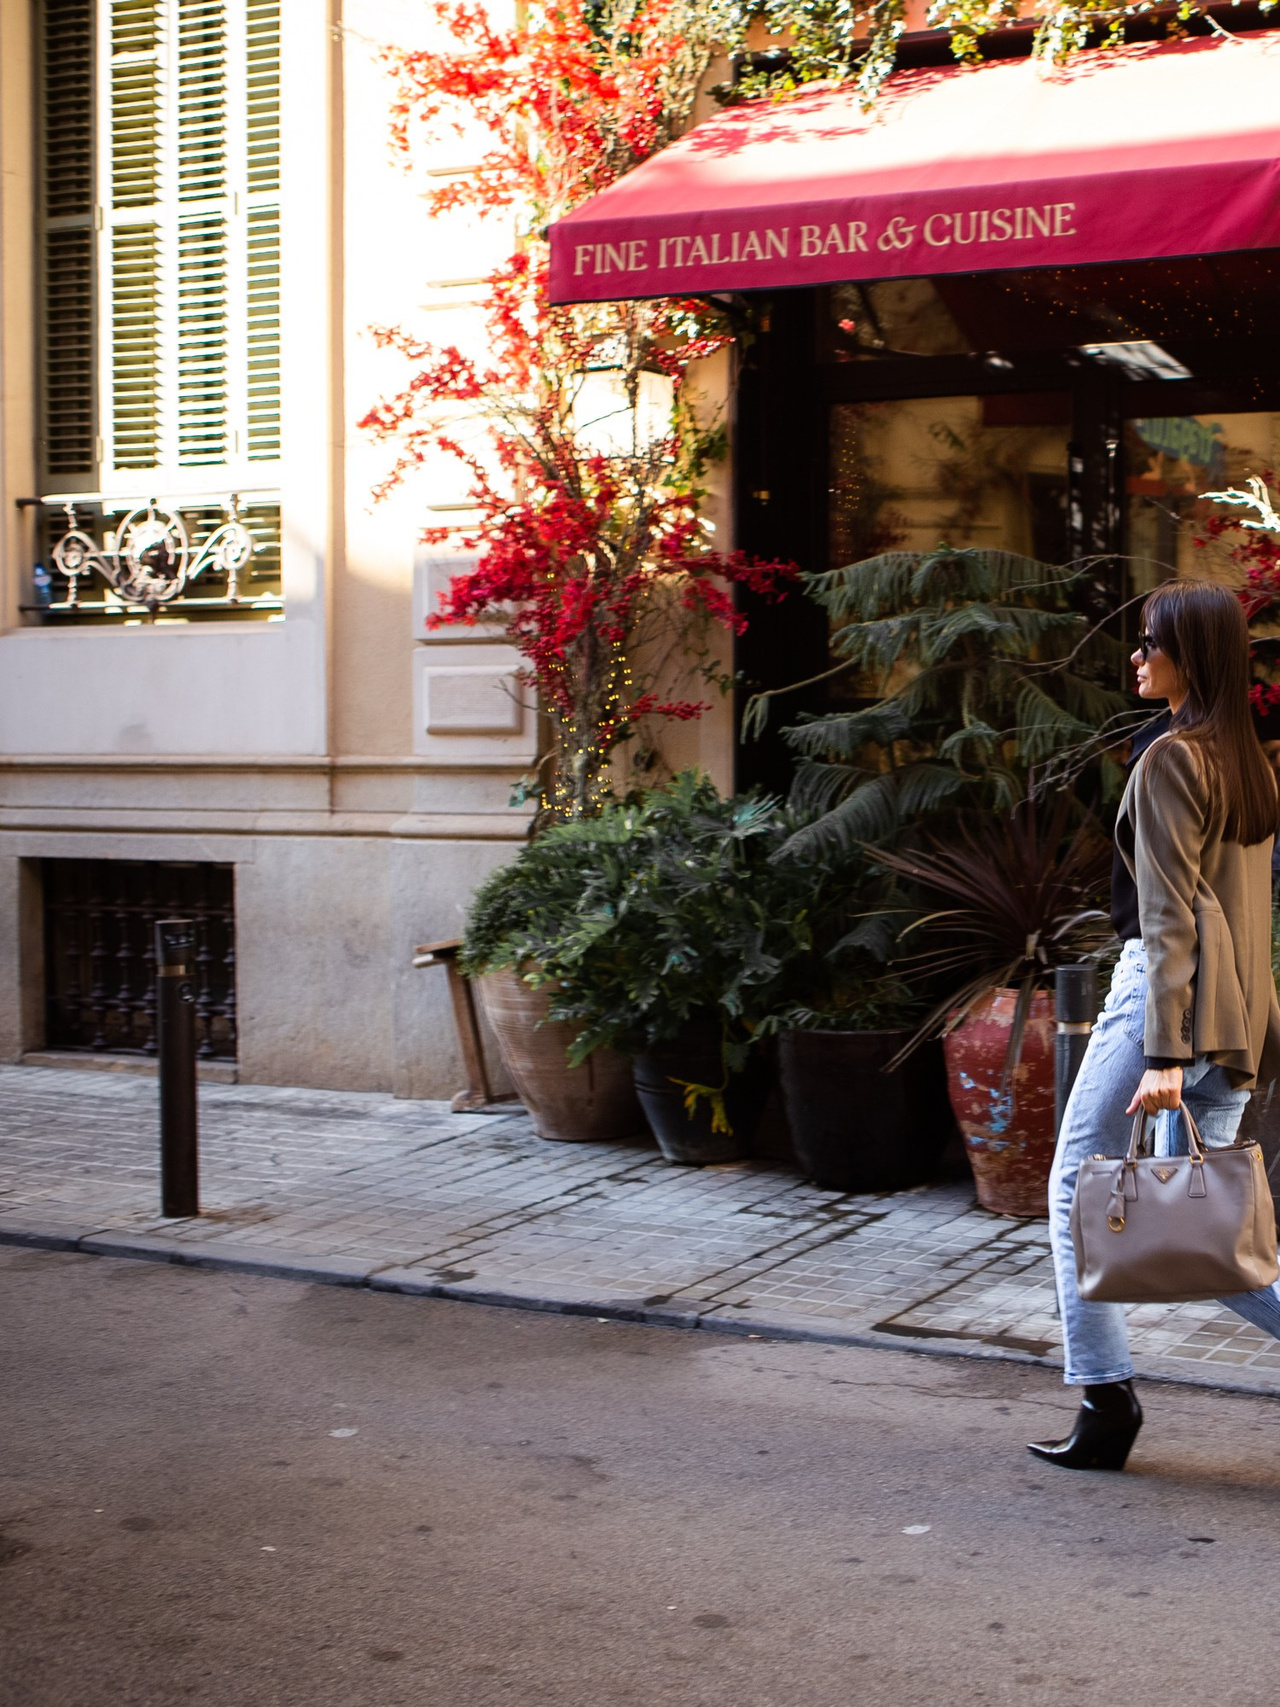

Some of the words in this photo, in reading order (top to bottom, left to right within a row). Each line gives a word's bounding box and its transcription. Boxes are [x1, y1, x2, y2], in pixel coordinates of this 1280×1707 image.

[573, 239, 649, 276] FINE
[657, 227, 790, 269] ITALIAN
[799, 221, 869, 257] BAR
[876, 216, 918, 251] &
[923, 202, 1077, 247] CUISINE
